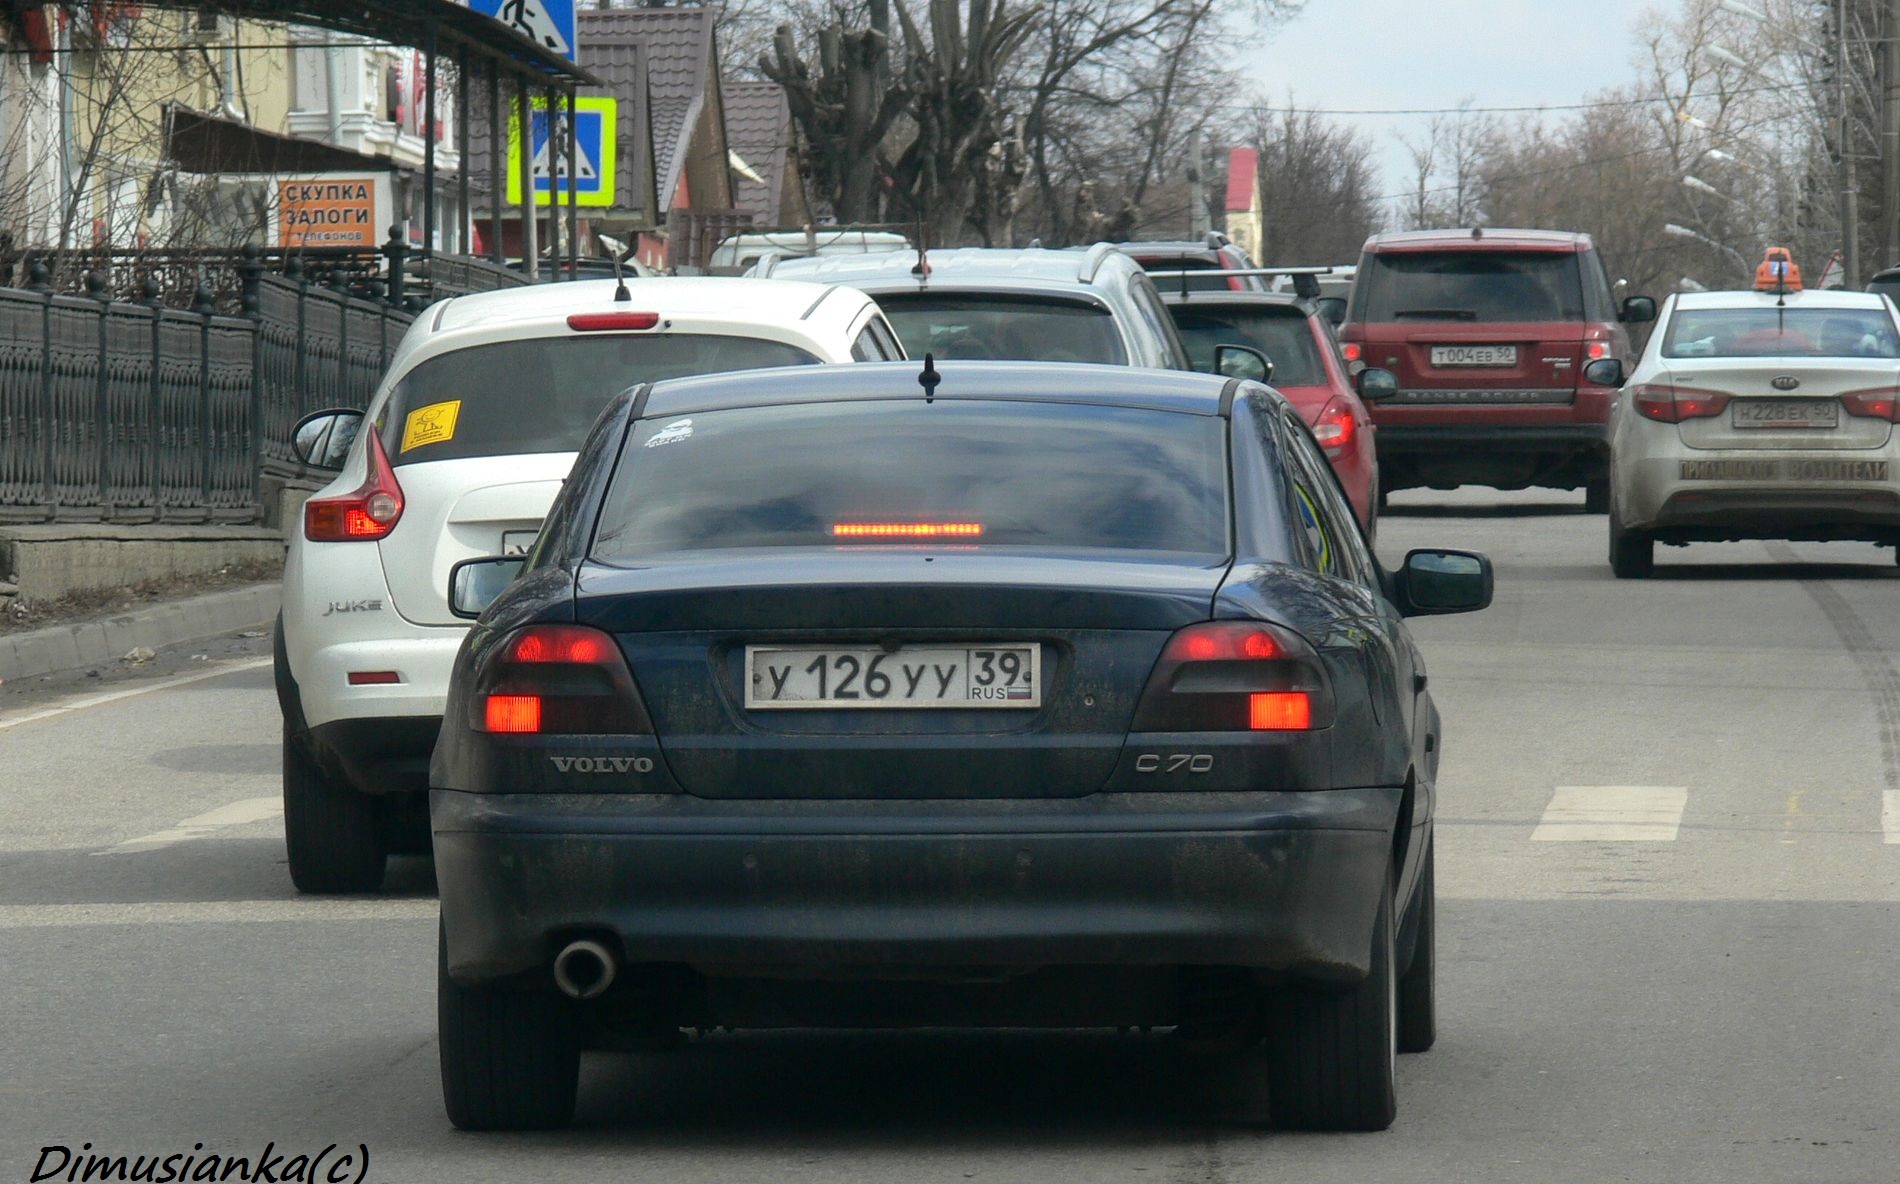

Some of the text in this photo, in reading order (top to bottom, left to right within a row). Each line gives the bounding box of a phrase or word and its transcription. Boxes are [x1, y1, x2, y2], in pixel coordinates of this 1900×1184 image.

[286, 184, 368, 201] СКУПКА
[286, 208, 369, 225] ЗАЛОГИ
[297, 232, 363, 241] ТЕЛЕФОНОВ
[321, 599, 382, 617] JUKE
[974, 651, 1021, 686] 39
[971, 687, 1006, 700] RUS
[549, 756, 654, 773] VOLVO
